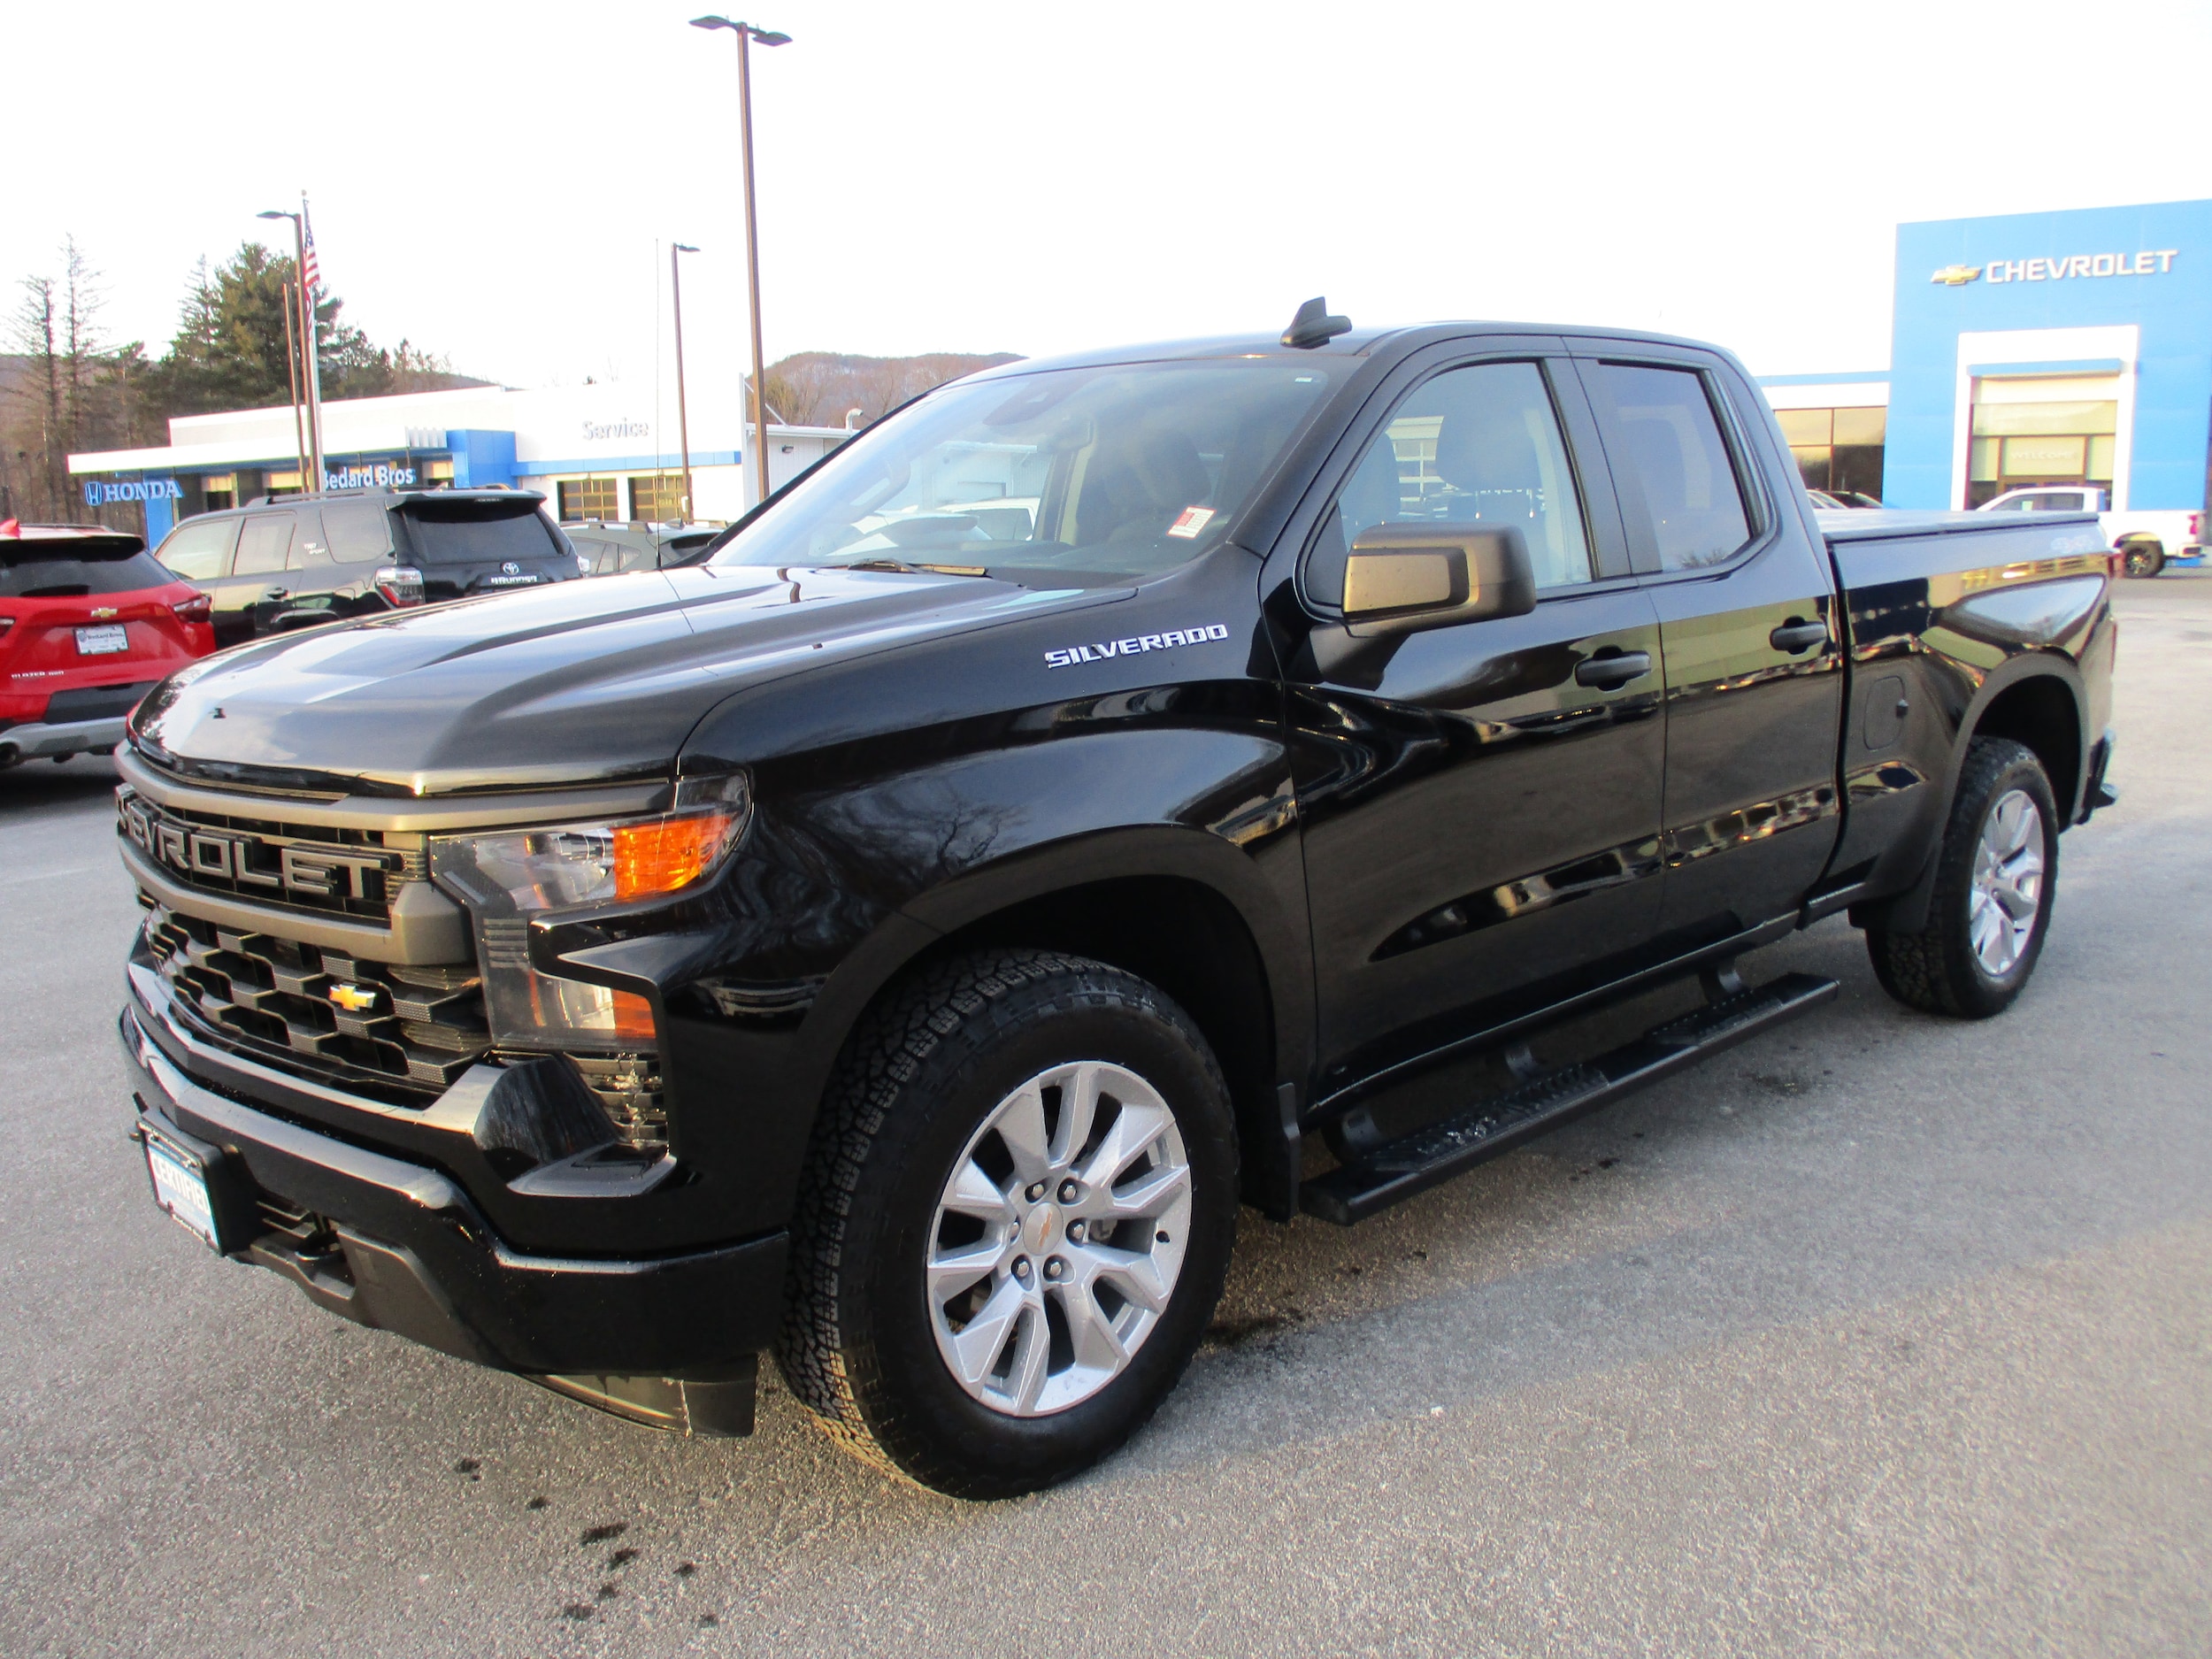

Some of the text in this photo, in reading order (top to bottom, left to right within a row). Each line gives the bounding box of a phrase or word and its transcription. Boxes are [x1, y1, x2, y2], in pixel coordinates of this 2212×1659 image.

[1985, 249, 2179, 284] CHEVROLET
[582, 417, 649, 441] Service
[104, 480, 184, 503] HONDA
[1045, 624, 1228, 669] SILVERADO
[150, 1152, 211, 1217] CERTIFIED
